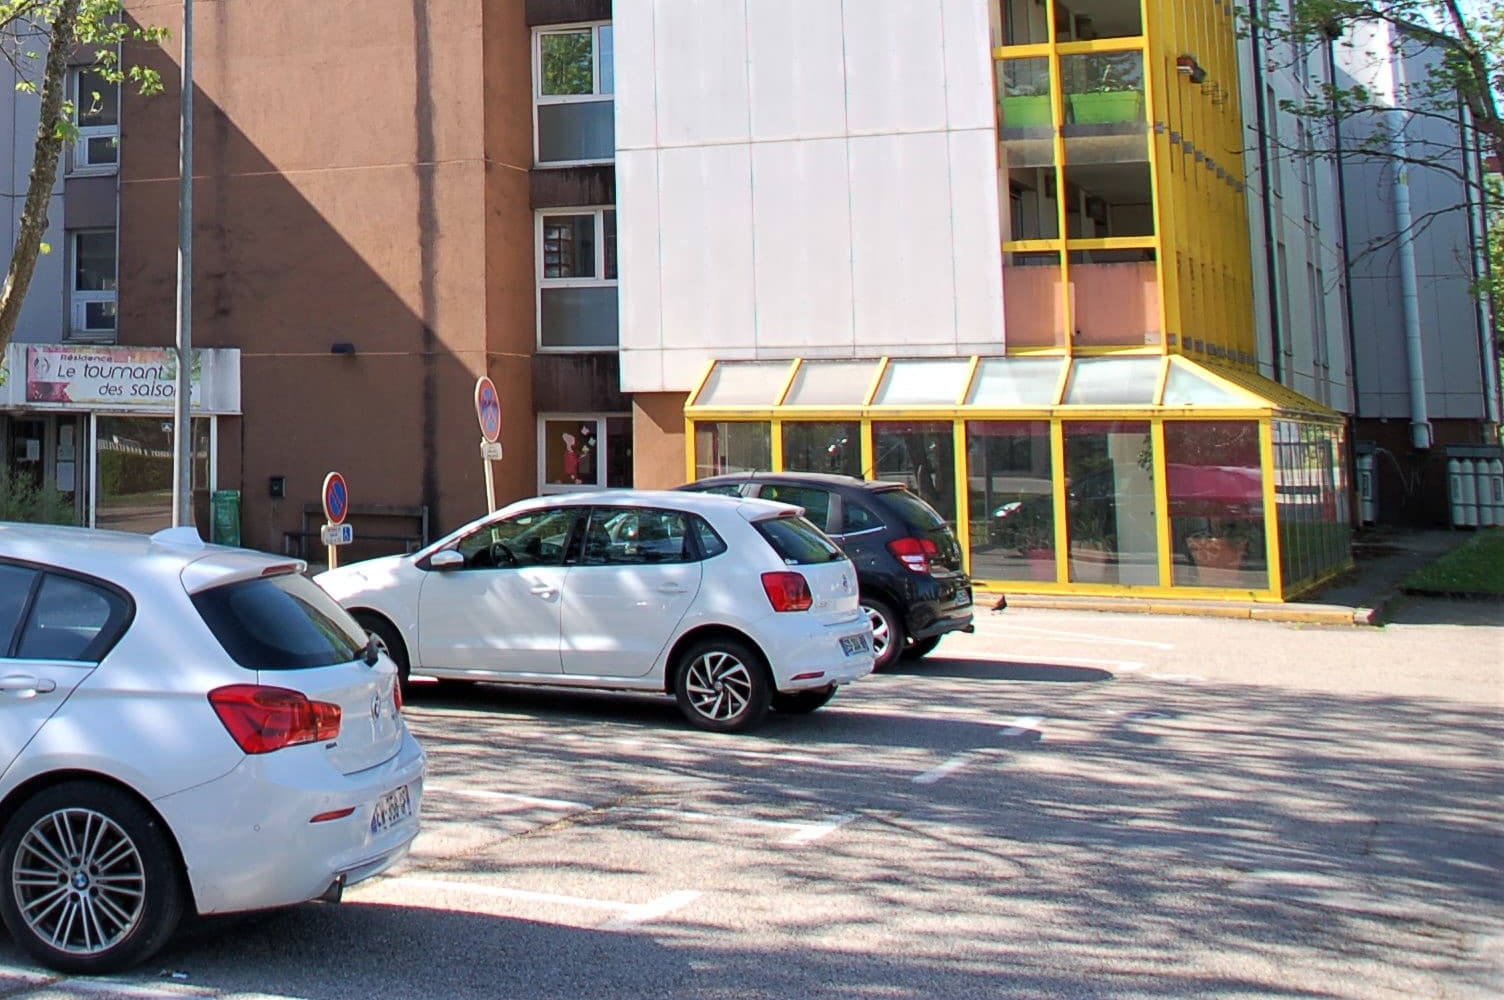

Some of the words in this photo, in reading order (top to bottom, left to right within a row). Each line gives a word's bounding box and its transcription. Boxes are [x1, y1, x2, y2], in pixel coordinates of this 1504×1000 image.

[57, 364, 76, 378] Le
[83, 363, 164, 380] tournant
[98, 383, 123, 396] des
